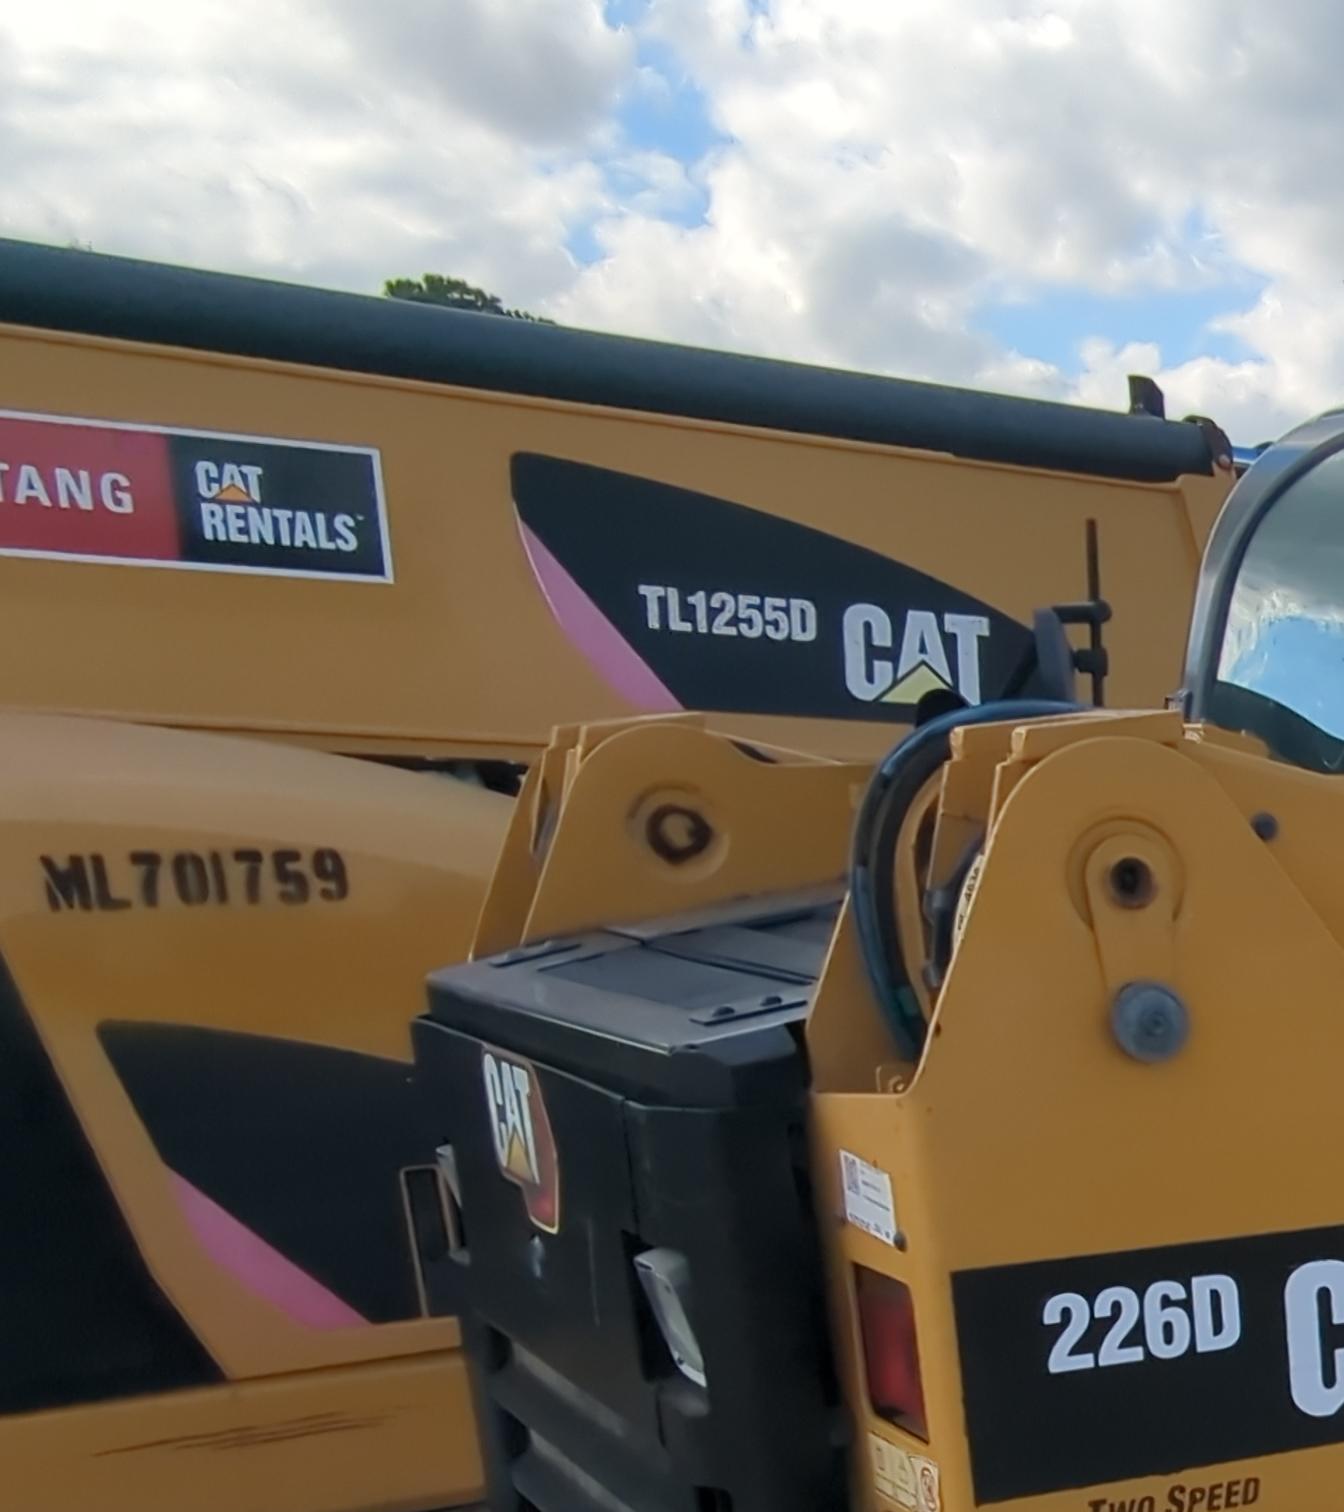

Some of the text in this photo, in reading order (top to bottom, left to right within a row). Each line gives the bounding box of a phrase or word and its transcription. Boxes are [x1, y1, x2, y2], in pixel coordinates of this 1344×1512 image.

[195, 460, 264, 504] CAT
[200, 502, 358, 552] RENTALS
[638, 583, 990, 706] TL1255D CAT
[39, 847, 350, 913] ML701759
[482, 1052, 540, 1184] CAT
[1042, 1274, 1242, 1374] 226D
